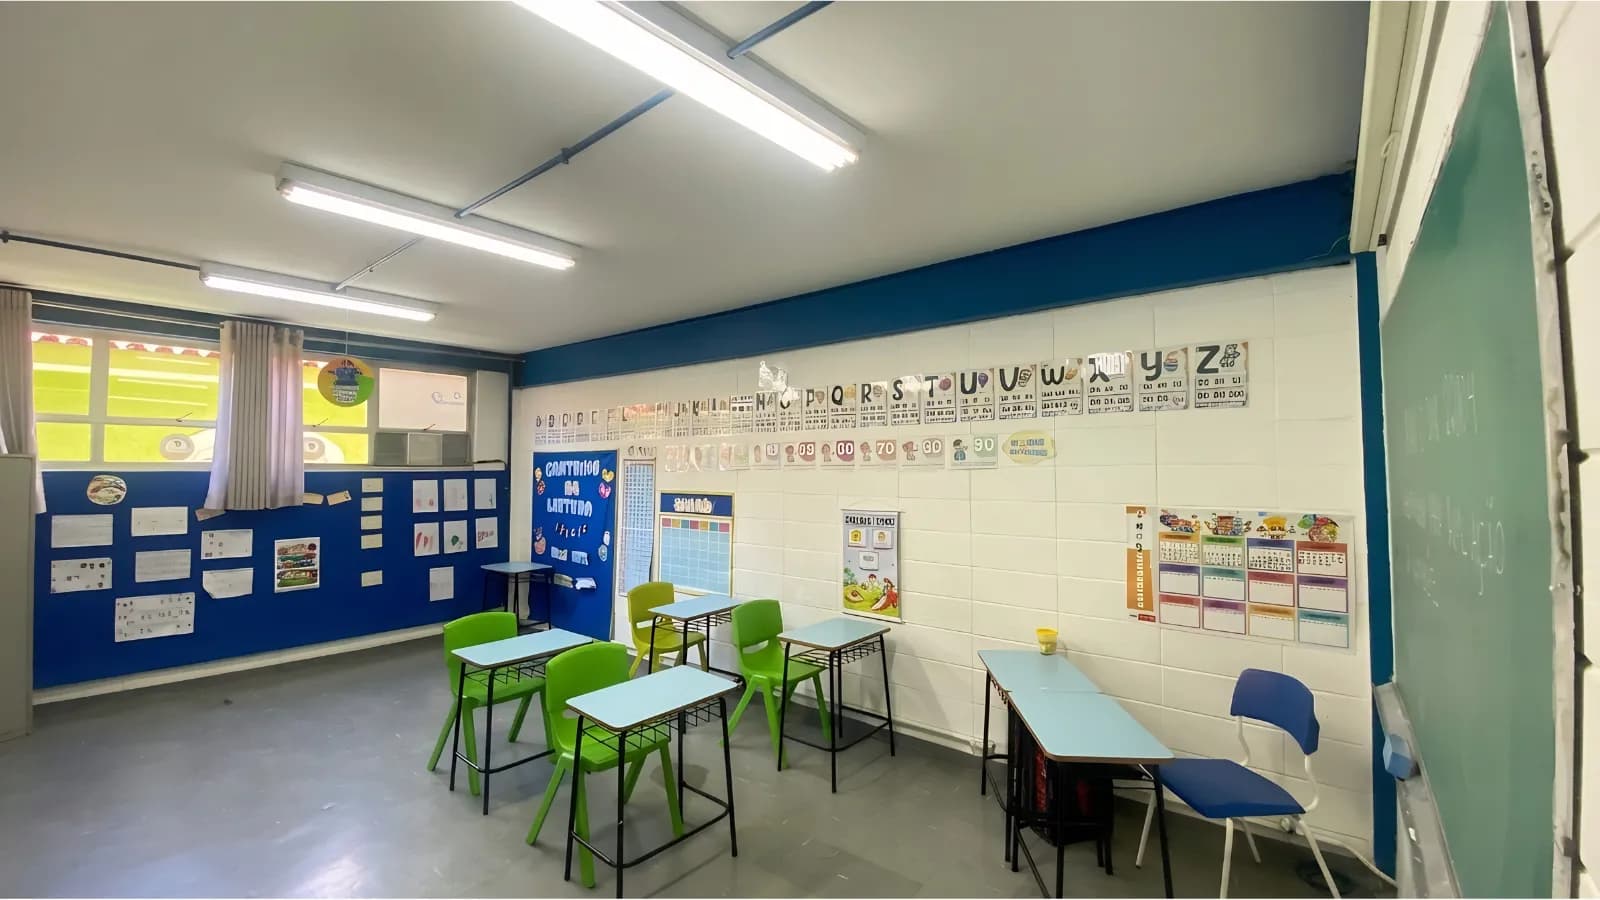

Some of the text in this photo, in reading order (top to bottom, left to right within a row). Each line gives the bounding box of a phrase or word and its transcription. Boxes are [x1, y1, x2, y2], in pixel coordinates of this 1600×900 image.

[805, 389, 815, 407] P
[831, 385, 844, 406] Q
[861, 383, 872, 404] R
[892, 379, 904, 401] S
[924, 375, 939, 398] T
[960, 371, 978, 395] U
[999, 366, 1020, 392] V
[1040, 366, 1065, 386] W
[1196, 345, 1221, 374] Z
[876, 442, 895, 455] 70
[974, 438, 995, 452] 90
